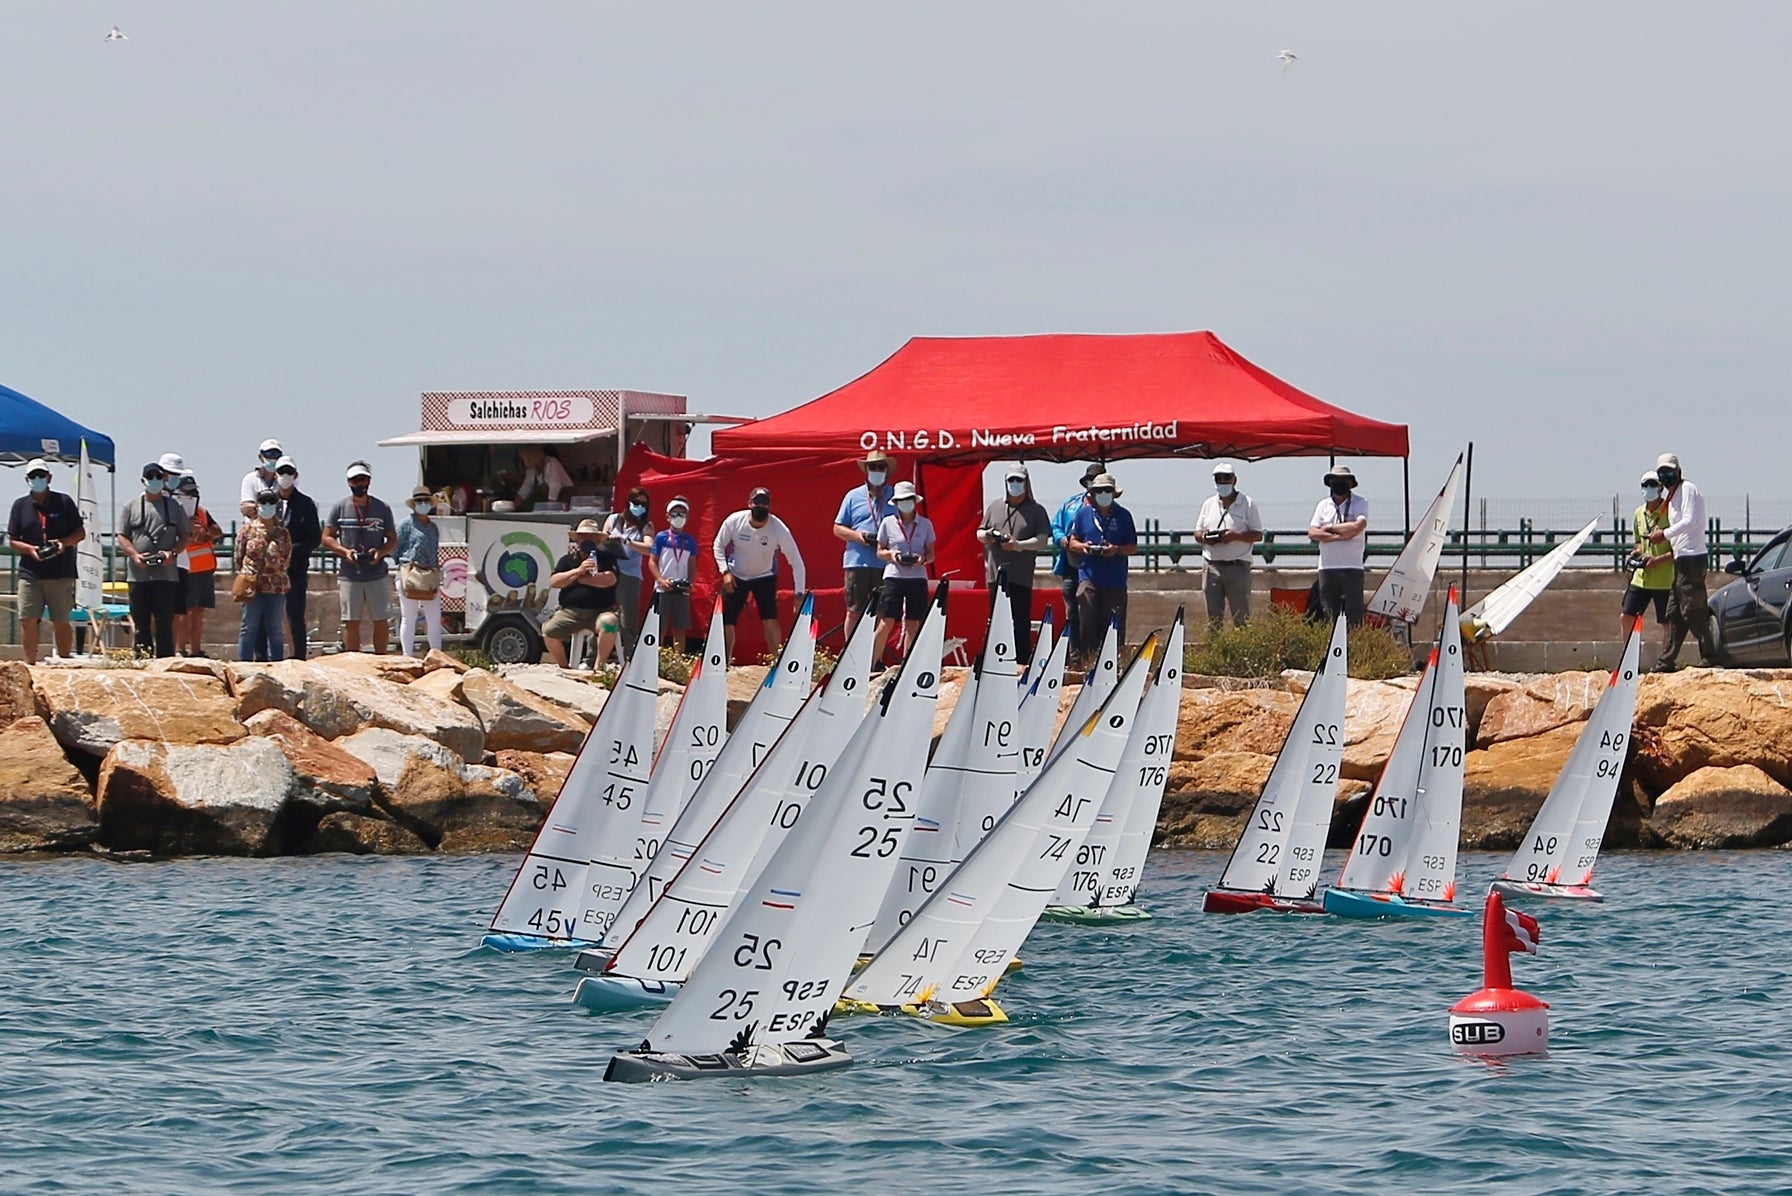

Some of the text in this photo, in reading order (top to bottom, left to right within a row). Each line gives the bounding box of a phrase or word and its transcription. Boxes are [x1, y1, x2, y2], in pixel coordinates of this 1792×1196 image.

[470, 399, 572, 421] Salchichas RIOS
[859, 420, 1178, 450] O.N.G.D. Nueva Fraternidad
[1382, 600, 1397, 613] 17
[1431, 746, 1462, 768] 170
[1139, 766, 1165, 787] 176
[1311, 763, 1337, 785] 22
[1596, 759, 1619, 779] 94
[602, 783, 634, 811] 45
[850, 826, 902, 858] 25
[1040, 835, 1072, 861] 74
[1358, 834, 1392, 857] 170
[1256, 842, 1281, 865] 22
[1577, 856, 1595, 868] ESP
[1072, 871, 1100, 892] 176
[1289, 867, 1311, 881] ESP
[1526, 863, 1549, 882] 94
[1106, 885, 1129, 899] ESP
[1418, 877, 1442, 893] ESP
[527, 908, 562, 934] 45
[583, 909, 615, 926] ESP
[647, 944, 687, 972] 101
[893, 974, 924, 998] 74
[952, 975, 987, 990] ESP
[710, 989, 759, 1021] 25
[768, 1011, 815, 1032] ESP
[1453, 1025, 1500, 1042] SUB
